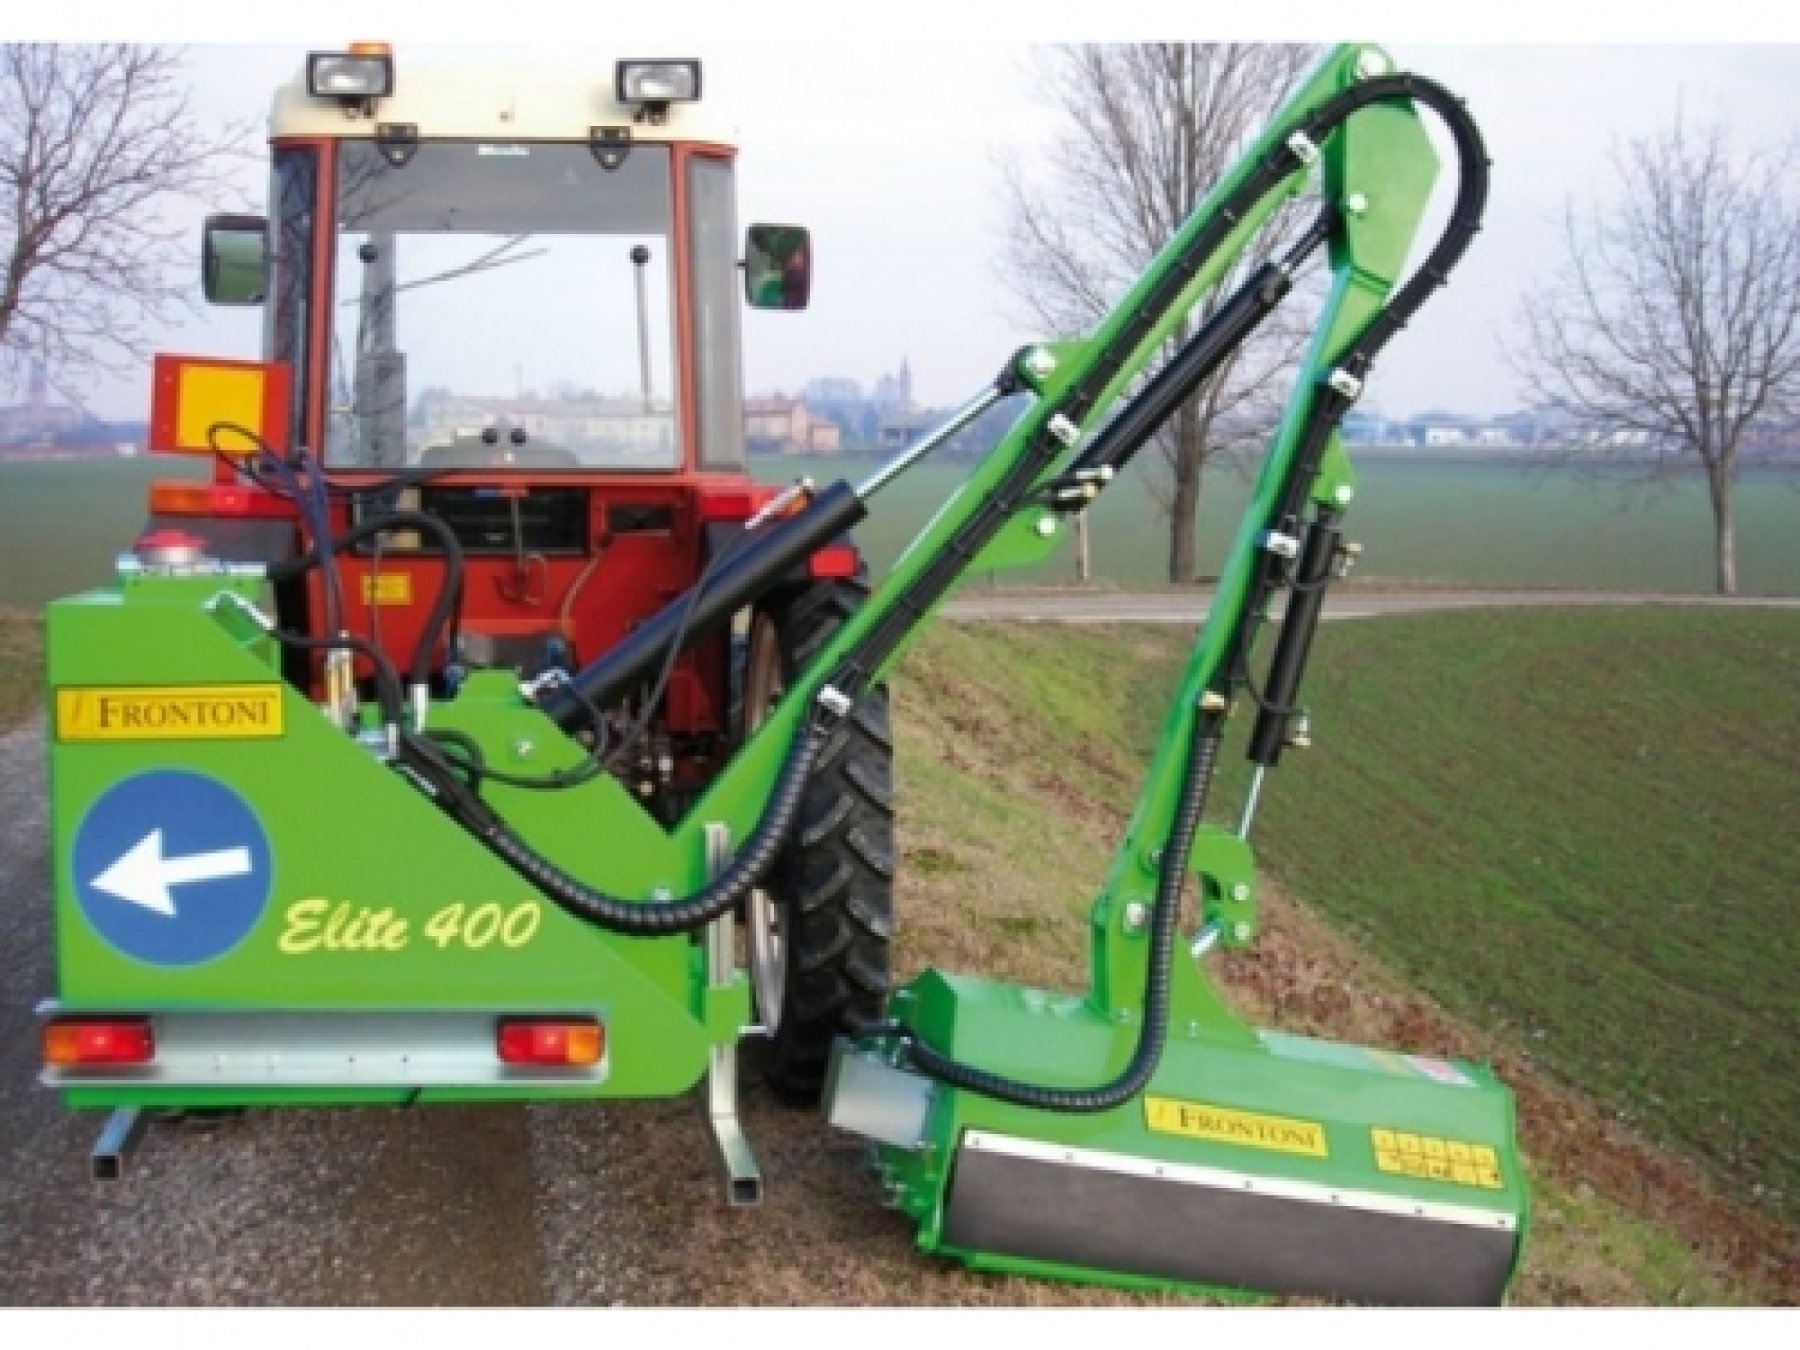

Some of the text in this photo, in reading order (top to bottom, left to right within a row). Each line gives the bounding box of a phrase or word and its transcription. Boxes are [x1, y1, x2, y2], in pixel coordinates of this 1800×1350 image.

[98, 696, 269, 728] FRONTONI
[279, 897, 541, 954] Elite 400
[1179, 1106, 1315, 1150] FRONTONI
